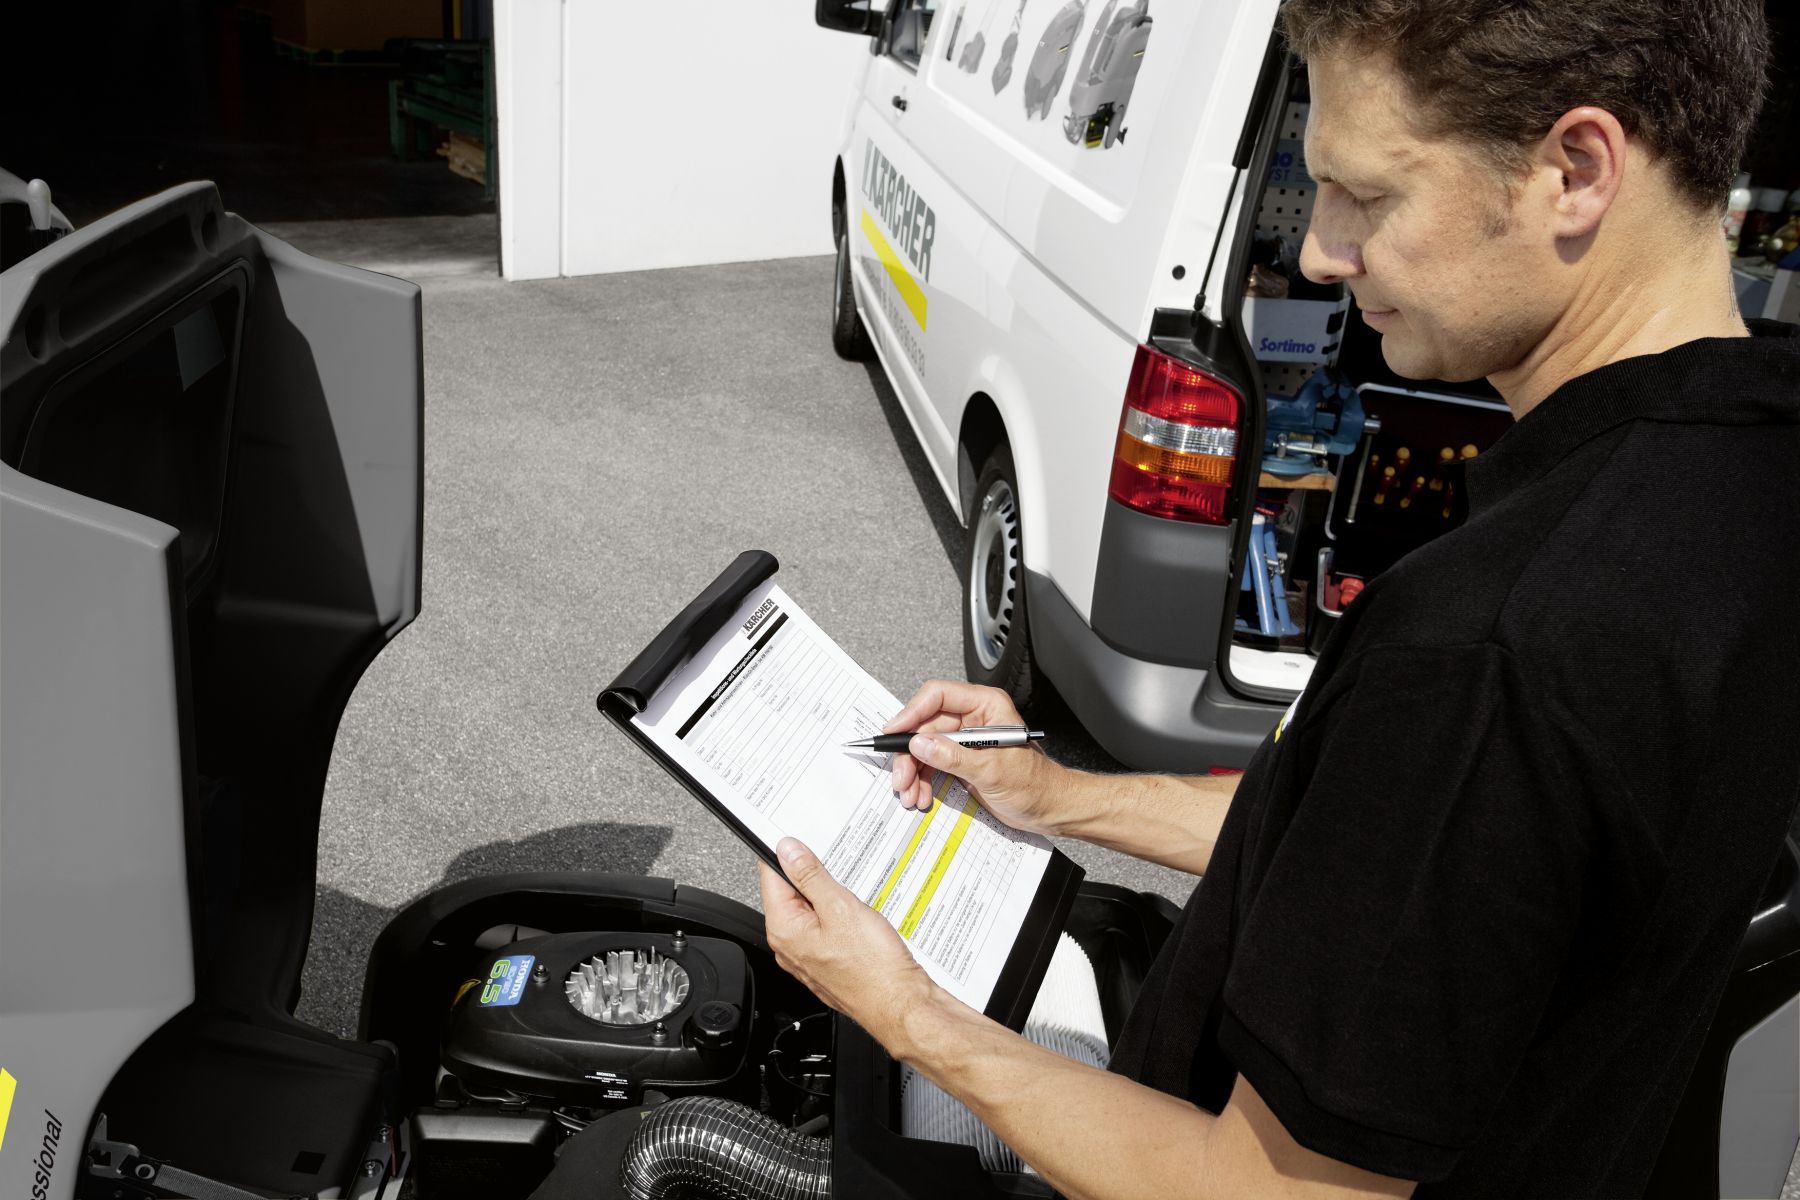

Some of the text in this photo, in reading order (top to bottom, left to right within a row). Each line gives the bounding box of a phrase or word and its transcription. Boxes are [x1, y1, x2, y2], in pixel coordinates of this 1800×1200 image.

[866, 142, 935, 283] KÄRCHER
[1260, 337, 1315, 354] Sortimo
[743, 598, 775, 632] KÄRCHER
[480, 959, 511, 1003] 6.5
[509, 960, 530, 1000] HONDA
